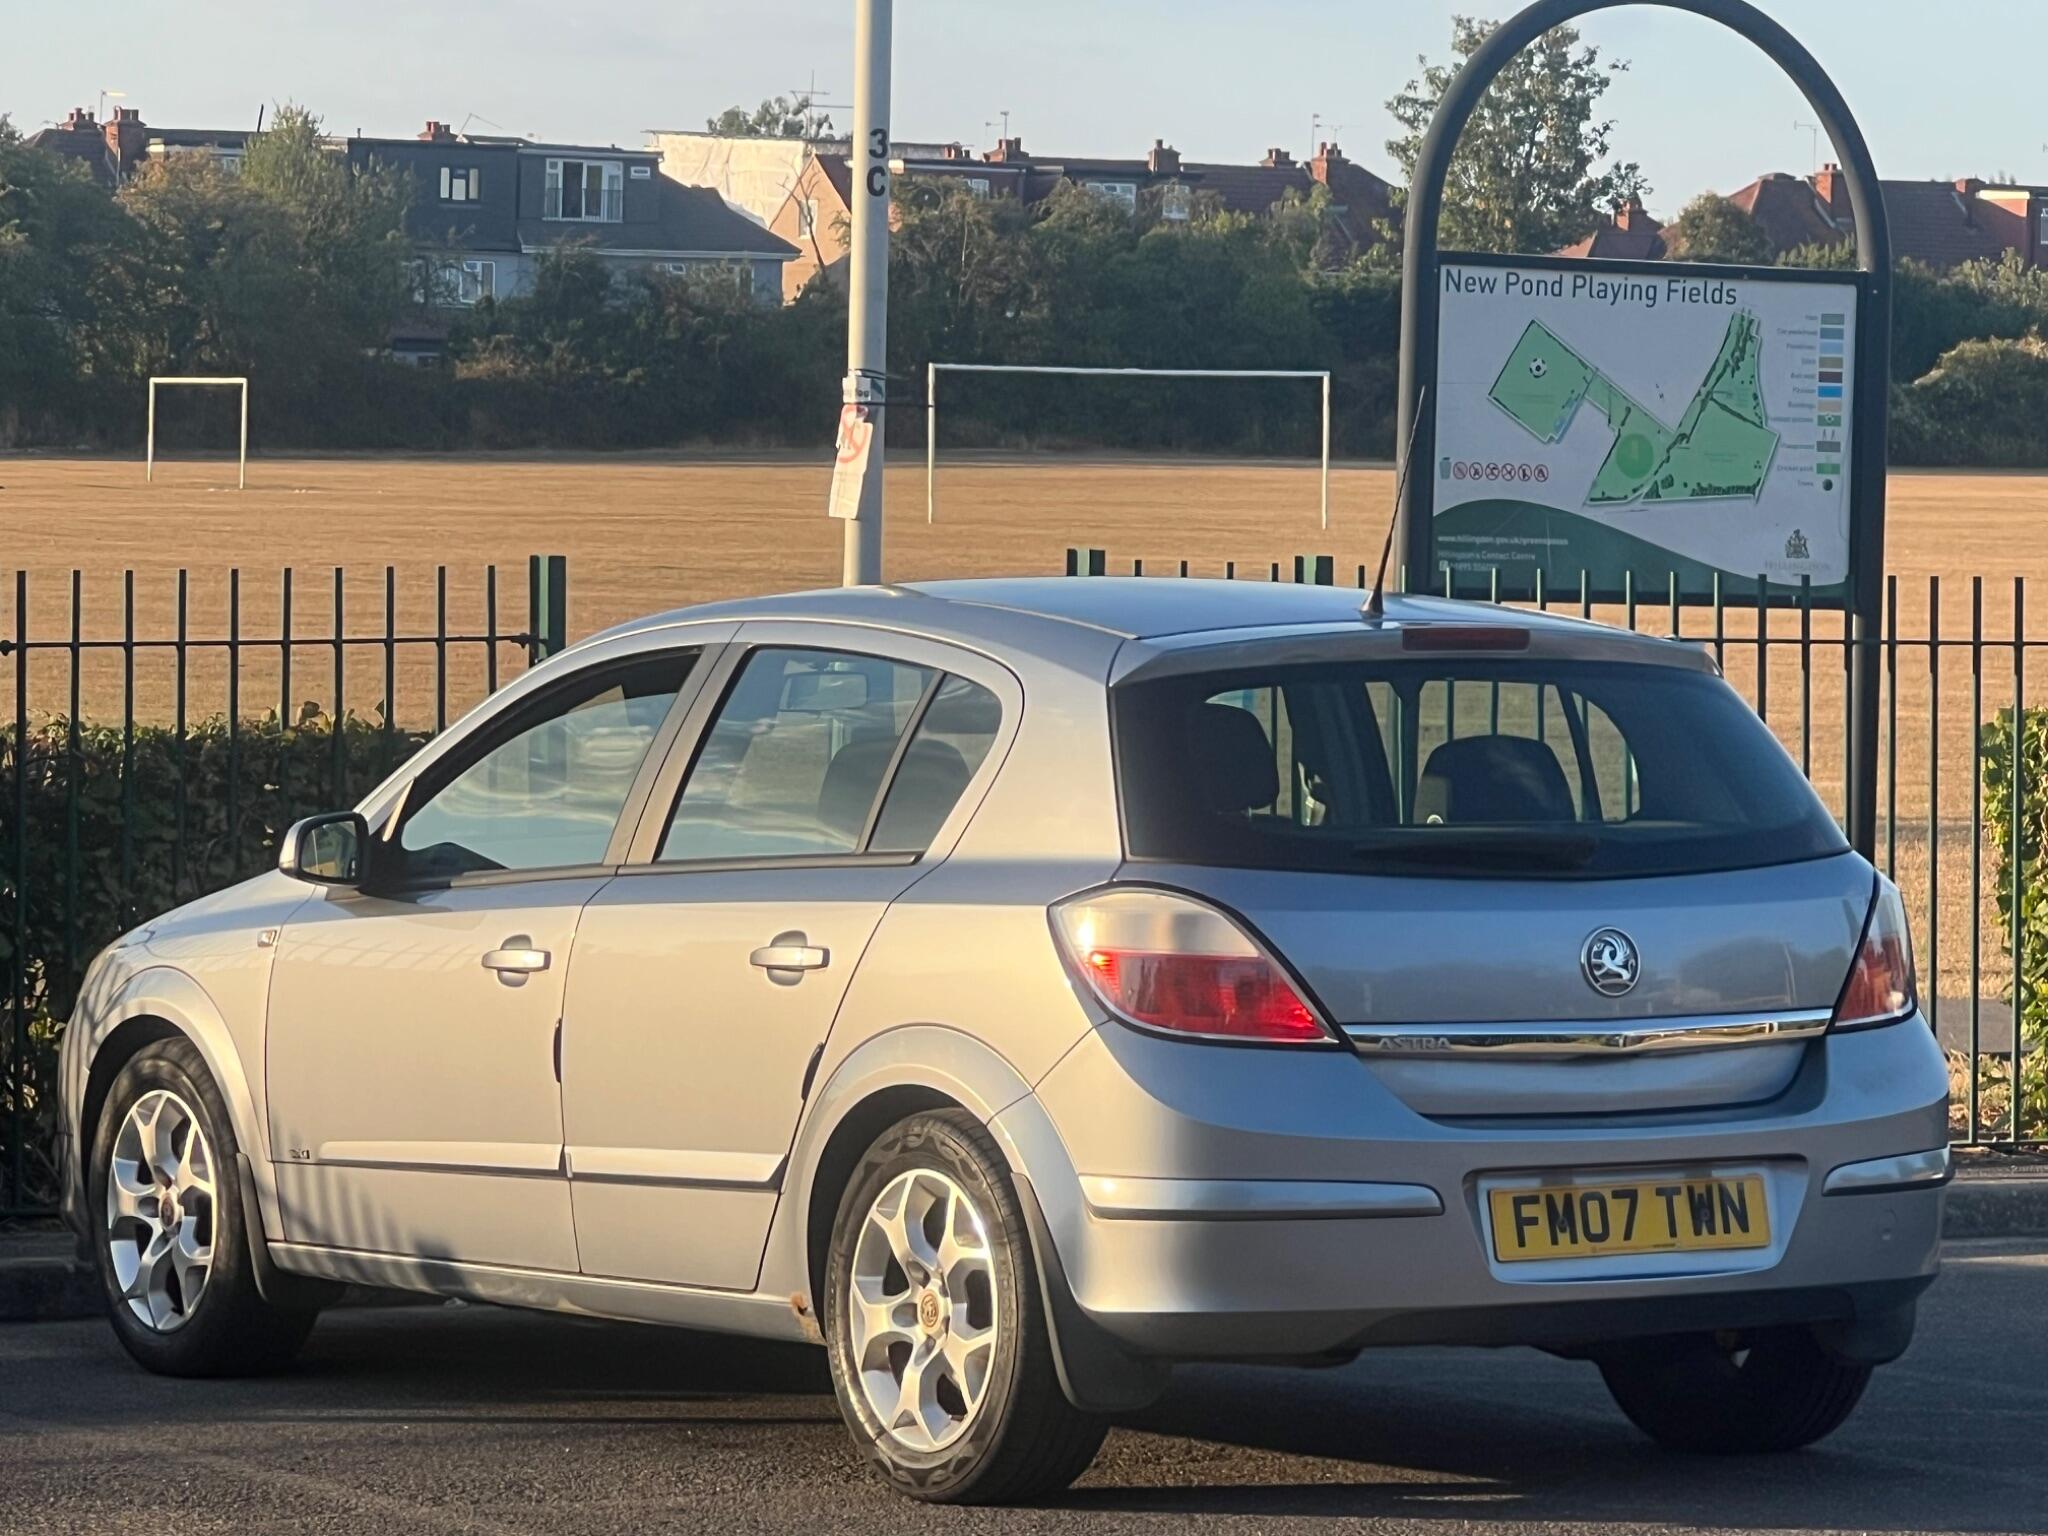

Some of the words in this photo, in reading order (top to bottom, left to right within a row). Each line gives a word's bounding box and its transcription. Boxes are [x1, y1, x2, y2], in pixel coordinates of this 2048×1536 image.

[868, 128, 888, 159] 3
[866, 165, 886, 197] C
[1445, 268, 1497, 295] New
[1505, 271, 1563, 298] Pond
[1572, 274, 1658, 308] Playing
[1666, 279, 1737, 305] Fields
[1376, 1037, 1453, 1050] ASTRA
[1512, 1187, 1639, 1248] FM07
[1655, 1182, 1750, 1239] TWN
